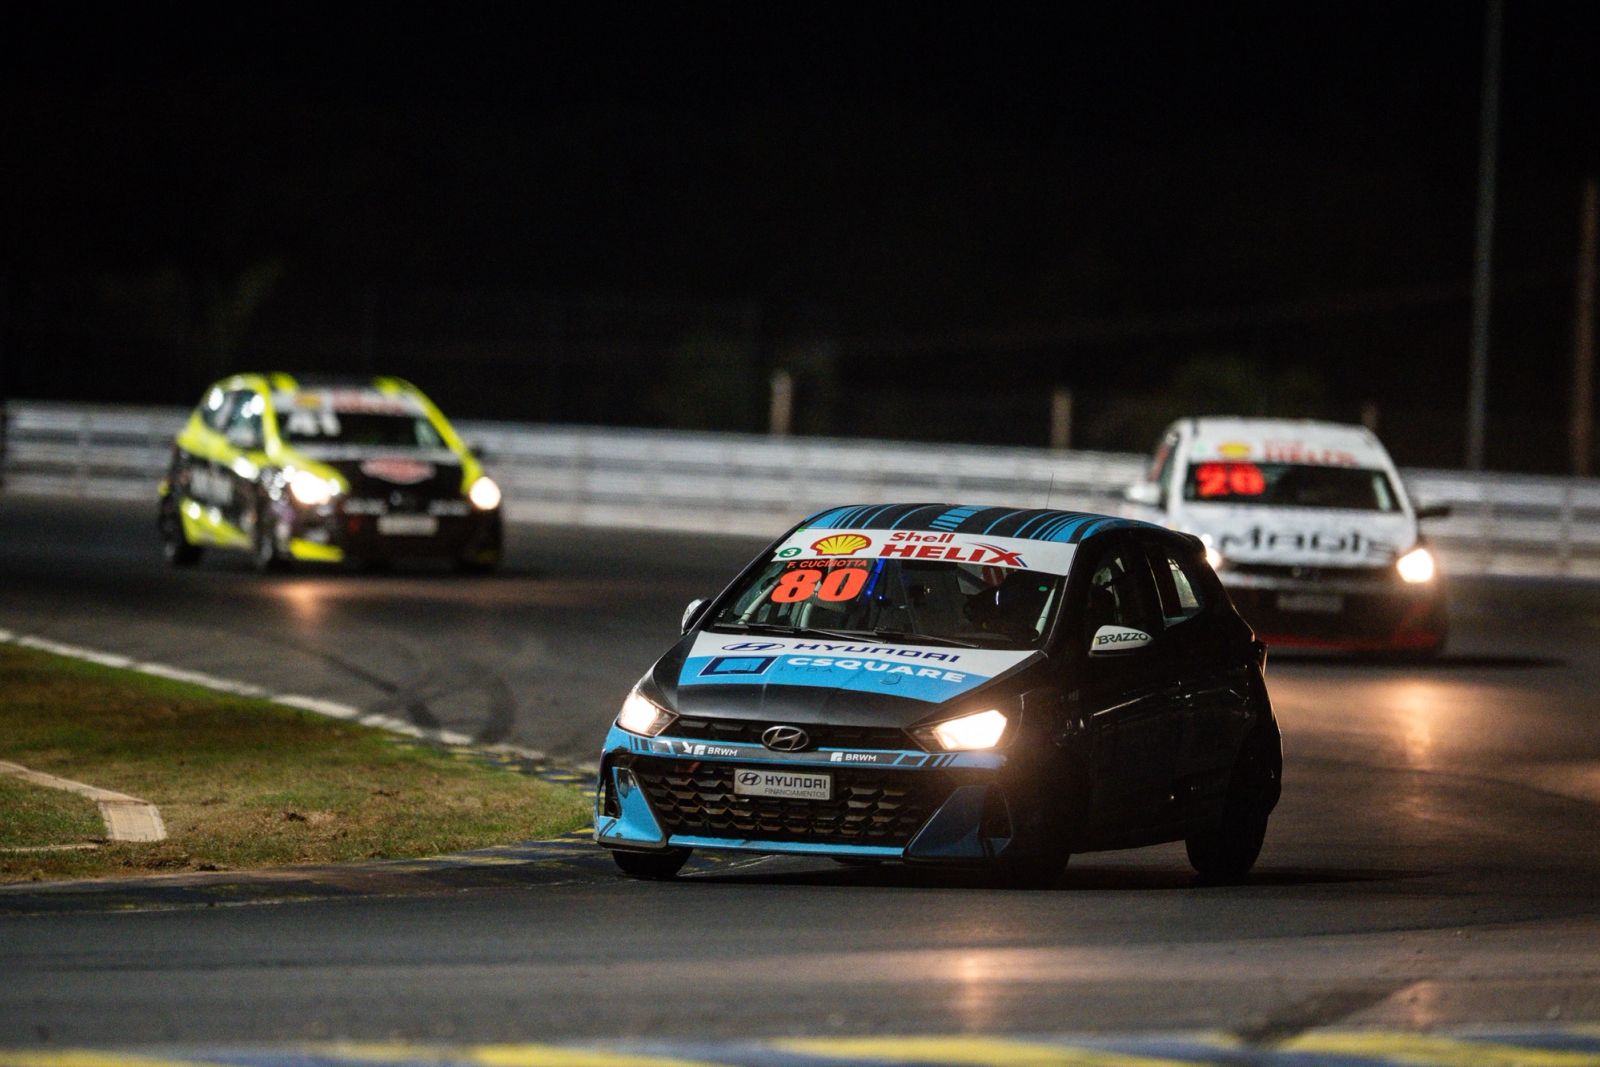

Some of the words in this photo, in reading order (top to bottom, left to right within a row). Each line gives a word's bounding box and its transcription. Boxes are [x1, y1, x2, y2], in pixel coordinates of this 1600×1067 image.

[889, 532, 955, 543] Shell
[879, 543, 1024, 567] HELIX
[771, 568, 868, 603] 80
[1096, 632, 1148, 645] BRAZZO
[793, 643, 960, 663] HYUNDAI
[787, 657, 967, 683] CSQUARE
[707, 746, 738, 757] BRWM
[845, 753, 877, 762] BRWM
[765, 775, 827, 789] HYUNDAI
[764, 787, 826, 798] FINANCIAMENTOS
